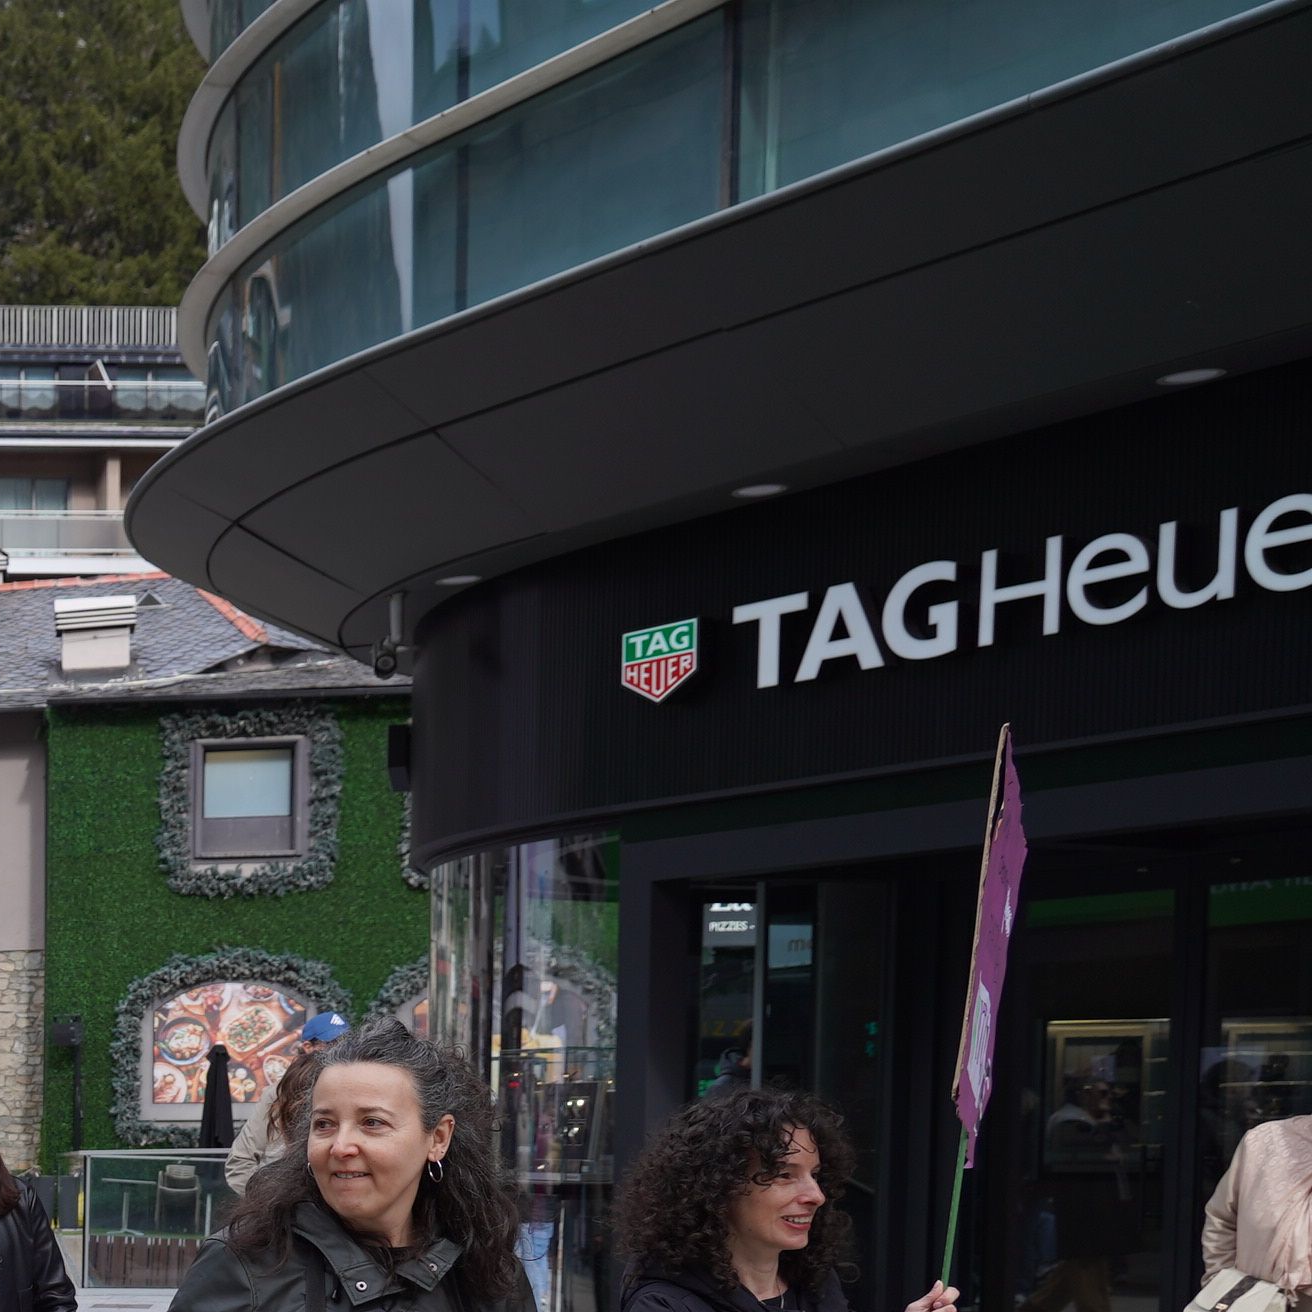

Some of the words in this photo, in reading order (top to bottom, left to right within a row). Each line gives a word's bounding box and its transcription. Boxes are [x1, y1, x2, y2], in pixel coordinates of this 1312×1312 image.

[628, 625, 690, 659] TAG
[732, 560, 959, 690] TAG
[626, 653, 692, 696] HEUER
